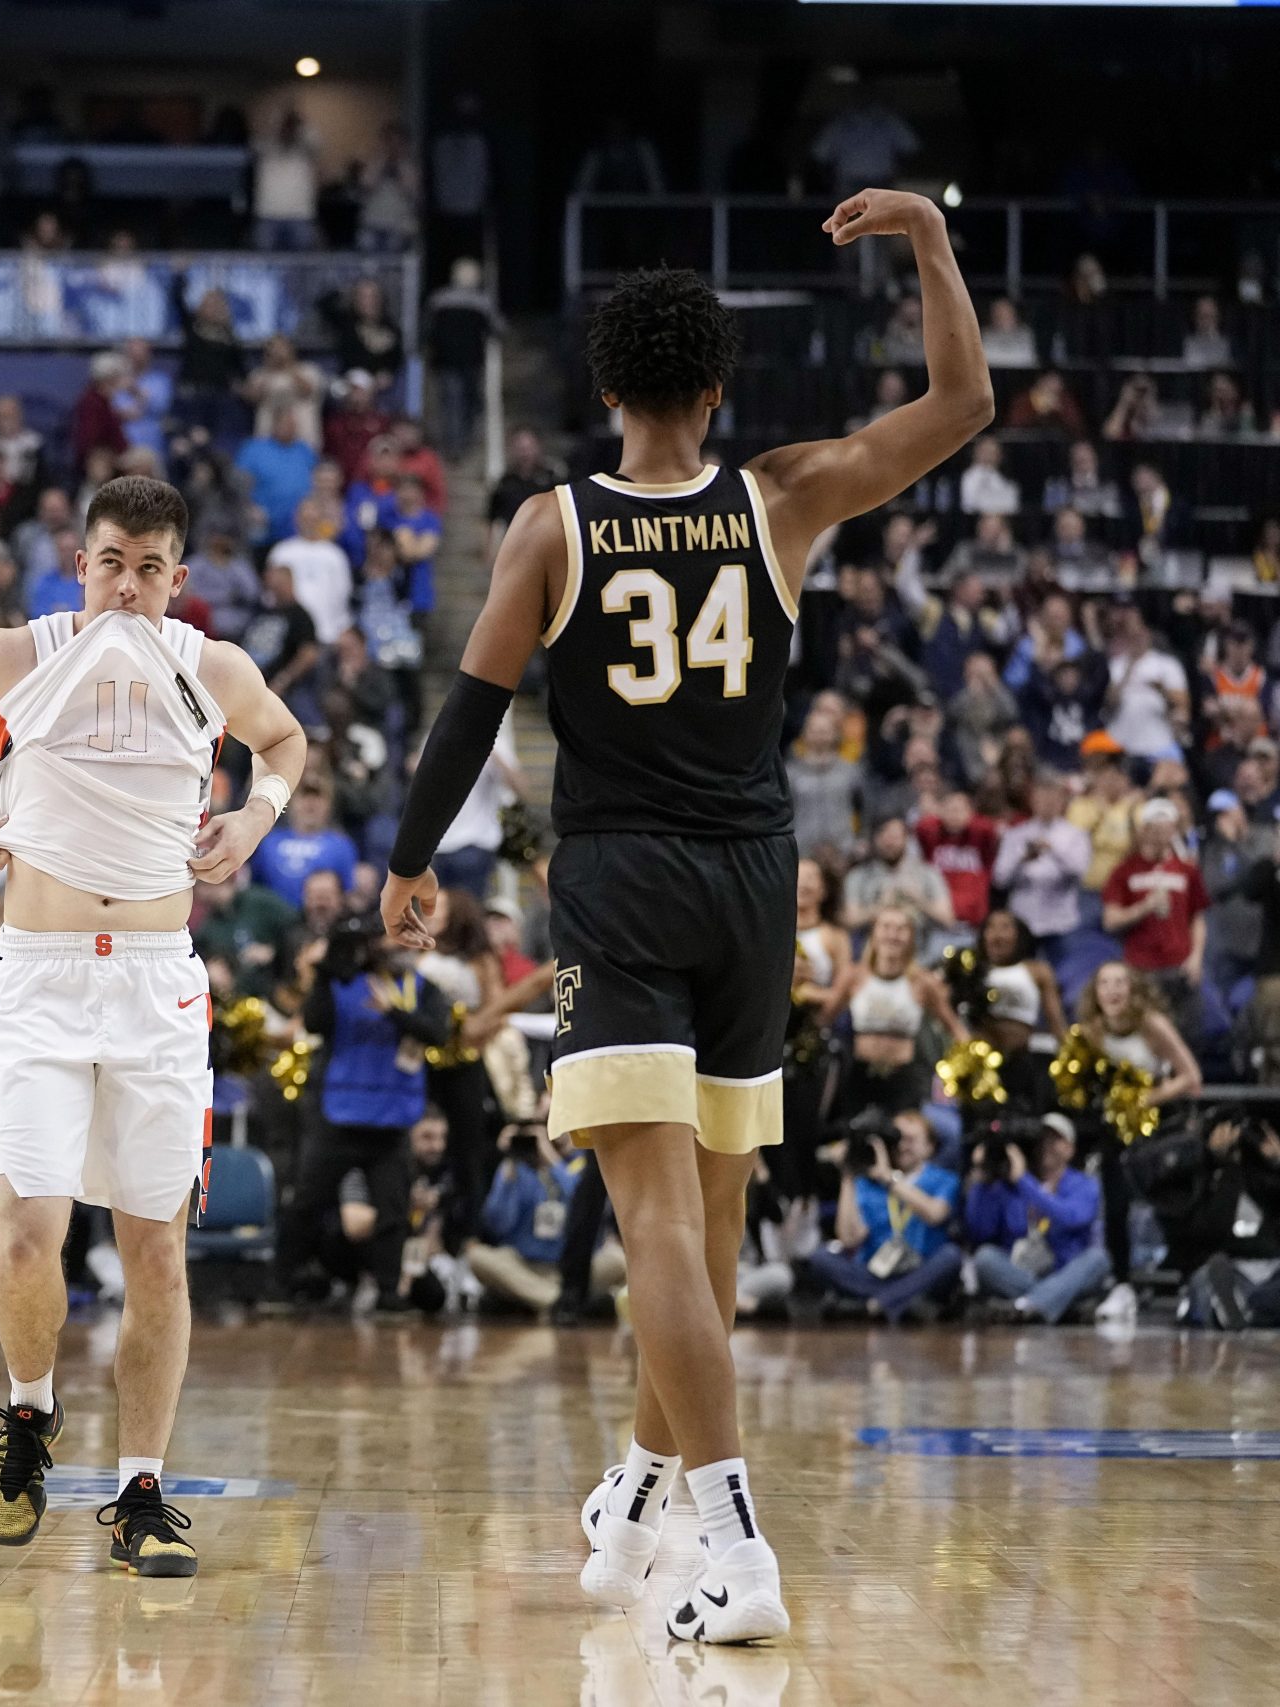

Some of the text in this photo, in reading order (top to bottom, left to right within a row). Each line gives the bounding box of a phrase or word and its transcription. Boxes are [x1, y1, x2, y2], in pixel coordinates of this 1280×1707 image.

[589, 513, 751, 554] KLINTMAN
[600, 565, 753, 705] 34
[95, 933, 113, 957] S
